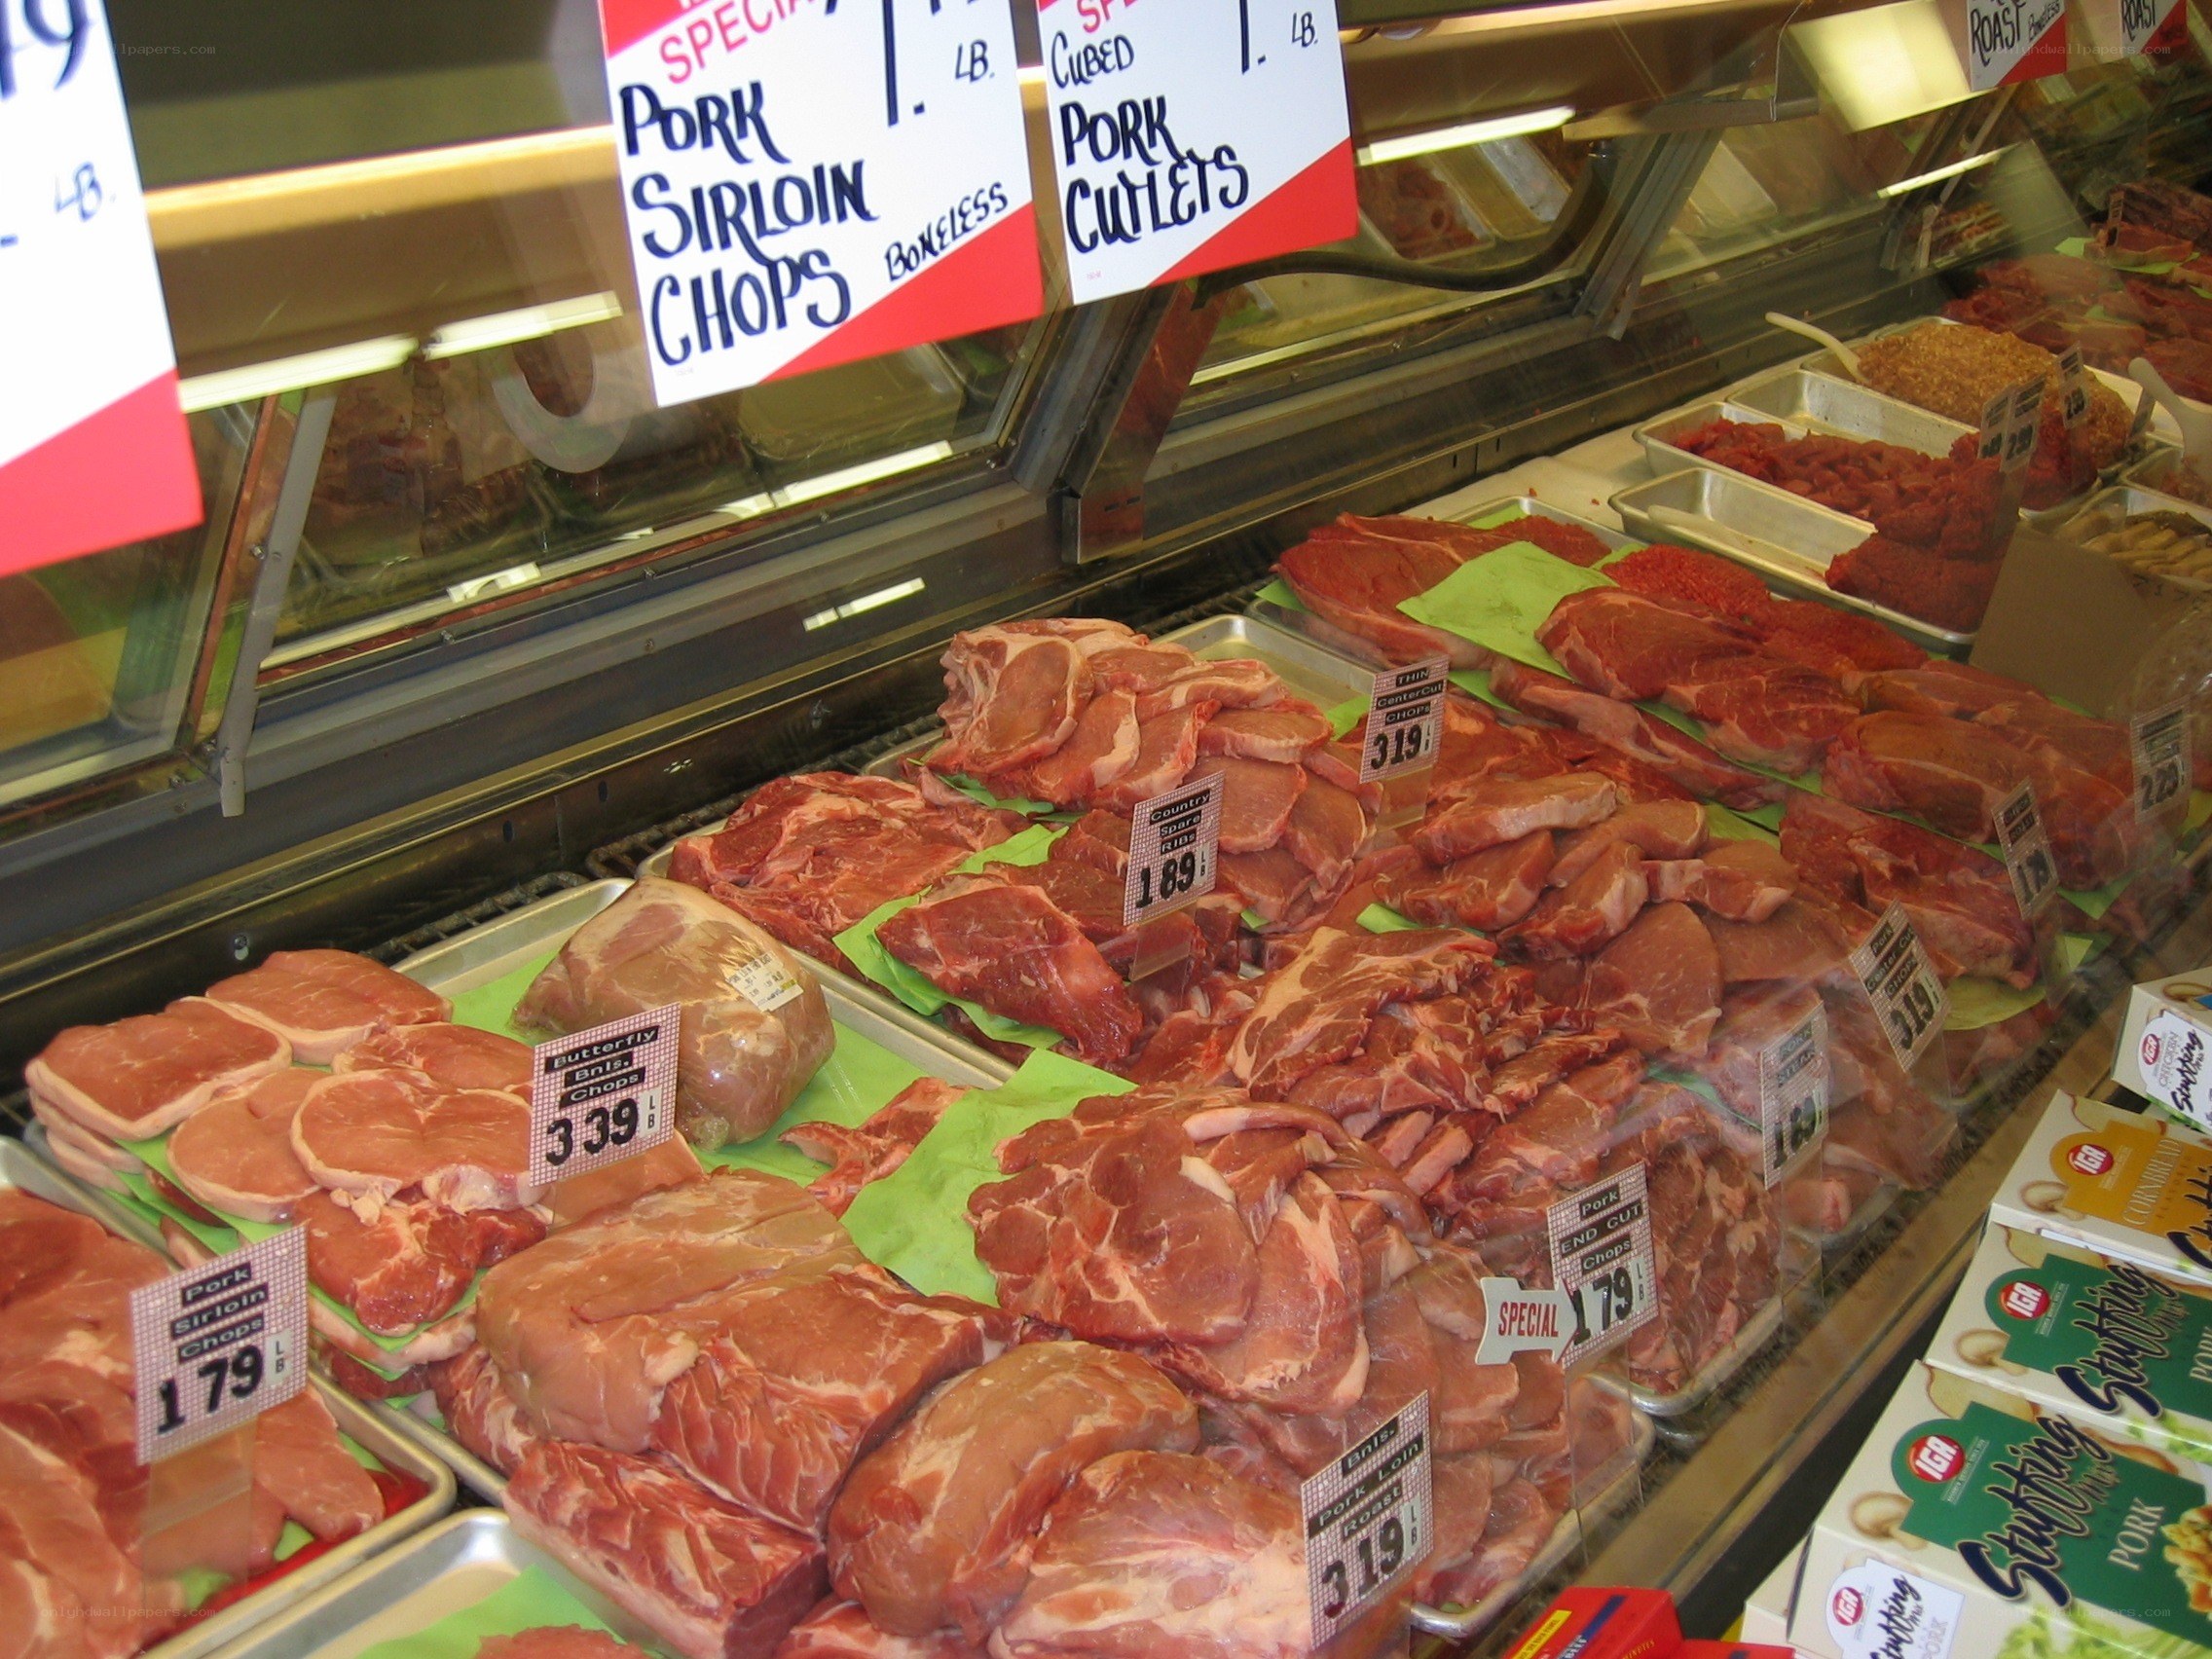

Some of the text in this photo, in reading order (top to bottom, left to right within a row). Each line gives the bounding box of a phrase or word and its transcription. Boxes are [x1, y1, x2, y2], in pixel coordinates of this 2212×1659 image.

[659, 0, 816, 84] SPEC
[1971, 1, 2026, 67] ROAST
[1051, 30, 1135, 89] CUBED
[619, 80, 792, 165] PORK
[1059, 94, 1182, 167] PORK
[630, 160, 880, 266] SIRLOIN
[1066, 145, 1249, 254] CUTLETS
[650, 248, 853, 367] CHOPS
[1397, 670, 1429, 684] THIN
[1151, 793, 1209, 822] Country
[1161, 814, 1200, 837] Spare
[554, 1027, 656, 1070] Butterfly
[574, 1058, 631, 1083] Bnls.
[571, 1073, 640, 1102] Chops
[2073, 1144, 2108, 1175] IGA
[2122, 1138, 2182, 1226] CORNBREAD
[1581, 1190, 1619, 1216] Pork
[1561, 1203, 1641, 1255] END CUT
[1582, 1238, 1632, 1272] Chops
[185, 1269, 249, 1303] Pork
[2006, 1281, 2043, 1318] IGA
[173, 1289, 266, 1336] Sirloin
[1497, 1301, 1559, 1338] SPECIAL
[181, 1315, 263, 1359] Chops
[2053, 1262, 2180, 1419] Stuffing
[1915, 1435, 1959, 1481] IGA
[1318, 1442, 1419, 1529] Pork Loin
[1343, 1486, 1401, 1538] Roast
[1957, 1414, 2112, 1608] Stuffing
[2107, 1497, 2165, 1571] PORK
[1836, 1589, 1860, 1625] IGA
